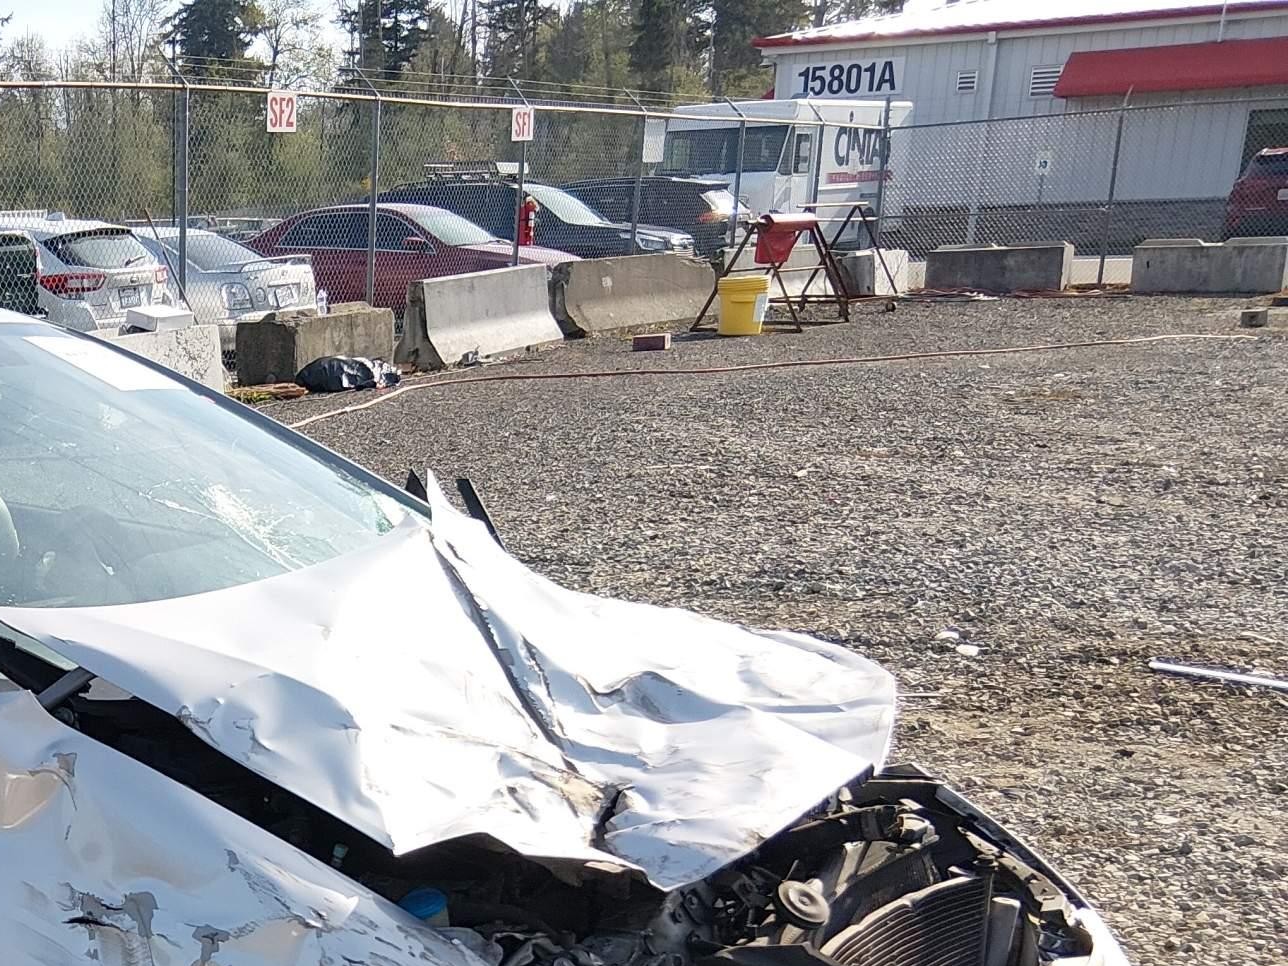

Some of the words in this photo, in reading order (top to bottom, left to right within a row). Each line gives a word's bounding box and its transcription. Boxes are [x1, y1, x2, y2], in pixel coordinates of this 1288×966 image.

[798, 60, 896, 96] 15801A
[269, 98, 294, 128] SF2
[515, 113, 530, 137] SF1
